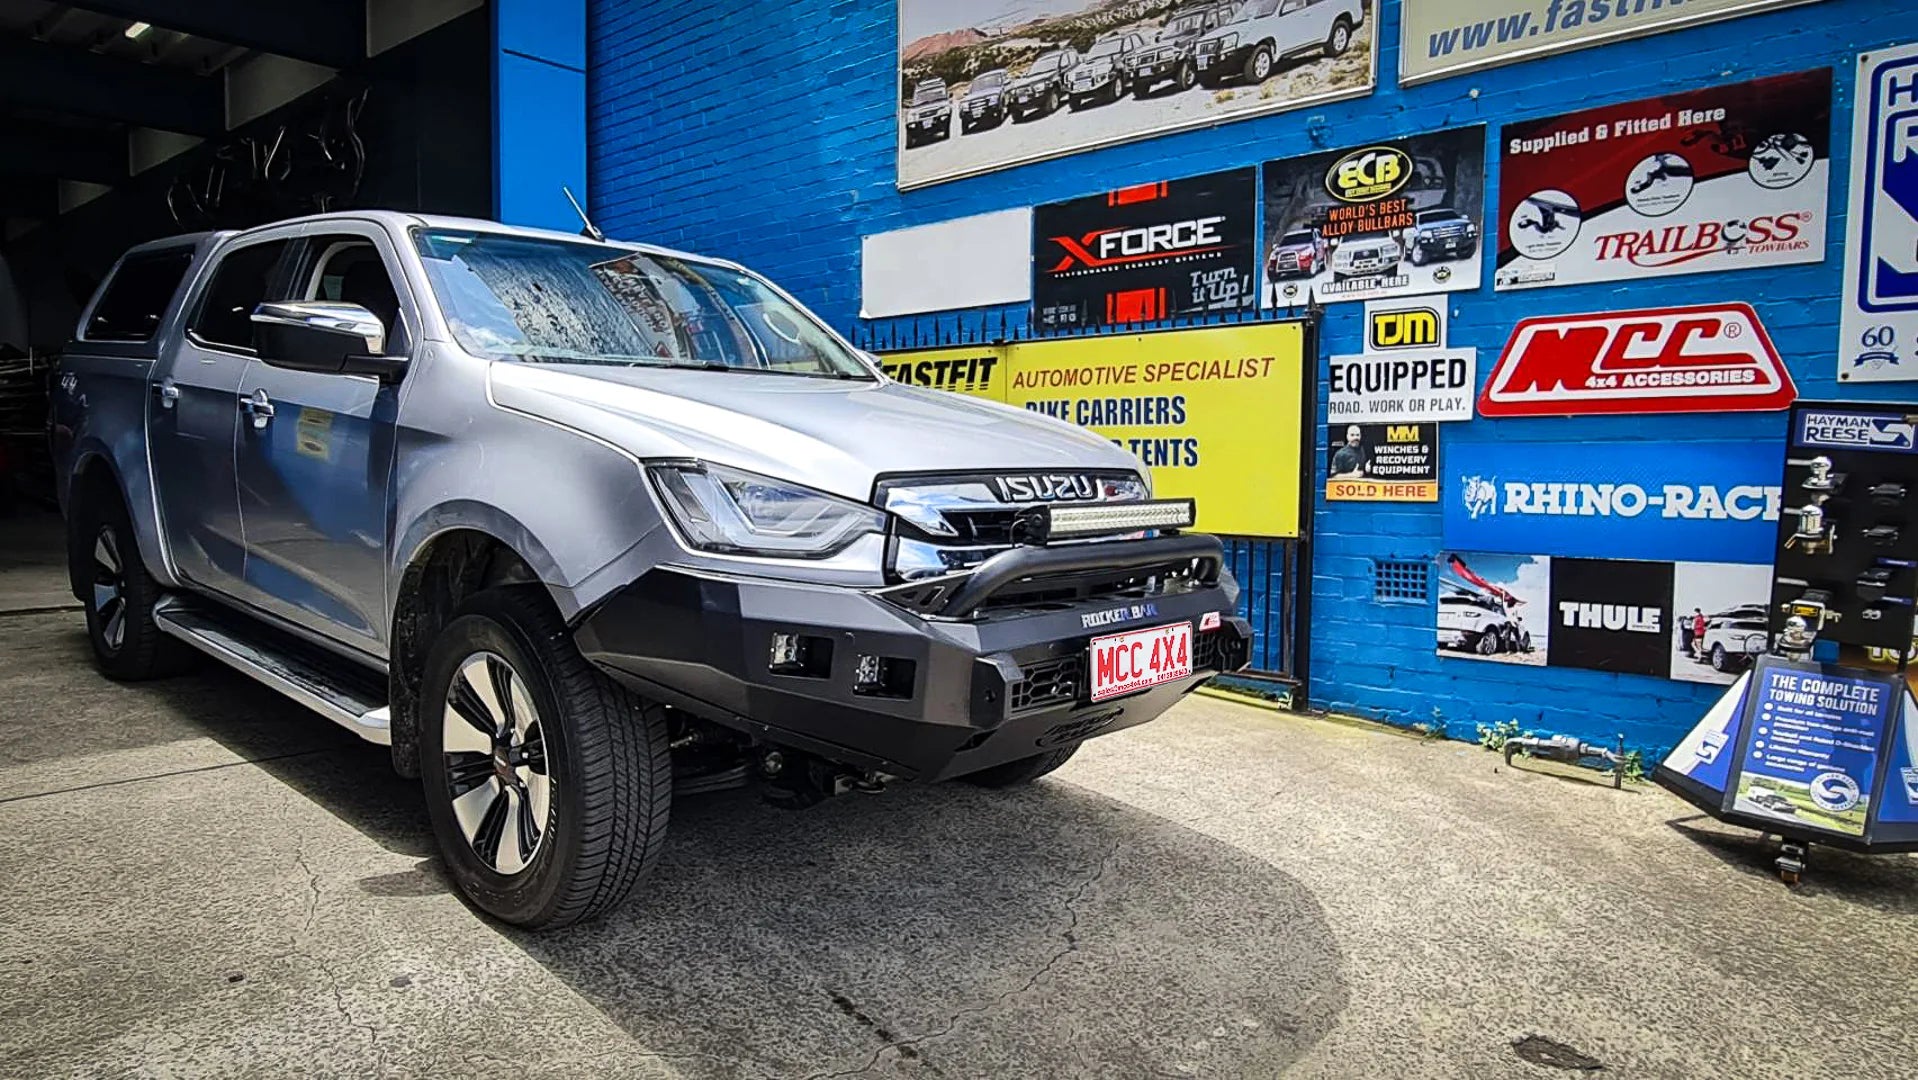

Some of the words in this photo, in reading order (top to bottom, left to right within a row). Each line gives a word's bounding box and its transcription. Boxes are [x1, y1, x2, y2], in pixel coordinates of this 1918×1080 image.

[1509, 127, 1589, 154] Supplied
[1595, 124, 1608, 140] &
[1614, 113, 1671, 137] Fitted
[1677, 107, 1726, 127] Here
[1337, 153, 1401, 188] ECB
[1329, 203, 1376, 221] WORLD'S
[1379, 199, 1407, 214] BEST
[1321, 221, 1354, 236] ALLOY
[1357, 213, 1414, 232] BULLBARS
[1749, 239, 1810, 255] TOWBARS
[1190, 267, 1237, 288] Turn
[1321, 278, 1377, 294] AVAILABLE
[1380, 274, 1409, 288] HERE
[1374, 312, 1436, 346] TJM
[1861, 325, 1894, 348] 60
[1497, 318, 1757, 393] MCC
[1013, 364, 1138, 388] AUTOMOTIVE
[1143, 357, 1275, 382] SPECIALIST
[1329, 358, 1467, 395] EQUIPPED
[1584, 375, 1617, 388] 4x4
[1622, 370, 1756, 387] ACCESSORIES
[1076, 396, 1186, 426] CARRIERS
[1329, 401, 1364, 414] ROAD.
[1369, 400, 1404, 413] WORK
[1409, 399, 1425, 412] OR
[1430, 397, 1466, 411] PLAY.
[1807, 415, 1871, 427] HAYMAN
[1806, 427, 1869, 442] REESE
[1128, 438, 1198, 467] TENTS
[1374, 445, 1419, 454] WINCHES
[1421, 445, 1429, 454] &
[1376, 455, 1428, 464] RECOVERY
[1372, 466, 1430, 475] EQUIPMENT
[995, 475, 1093, 501] ISUZU
[1336, 485, 1377, 497] SOLD
[1383, 485, 1427, 497] HERE
[1080, 608, 1131, 629] ROCKER
[1559, 601, 1661, 633] THULE
[1097, 641, 1143, 687] MCC
[1150, 632, 1188, 673] 4X4
[1772, 674, 1798, 690] THE
[1801, 678, 1880, 702] COMPLETE
[1769, 688, 1814, 706] TOWING
[1816, 695, 1878, 715] SOLUTION
